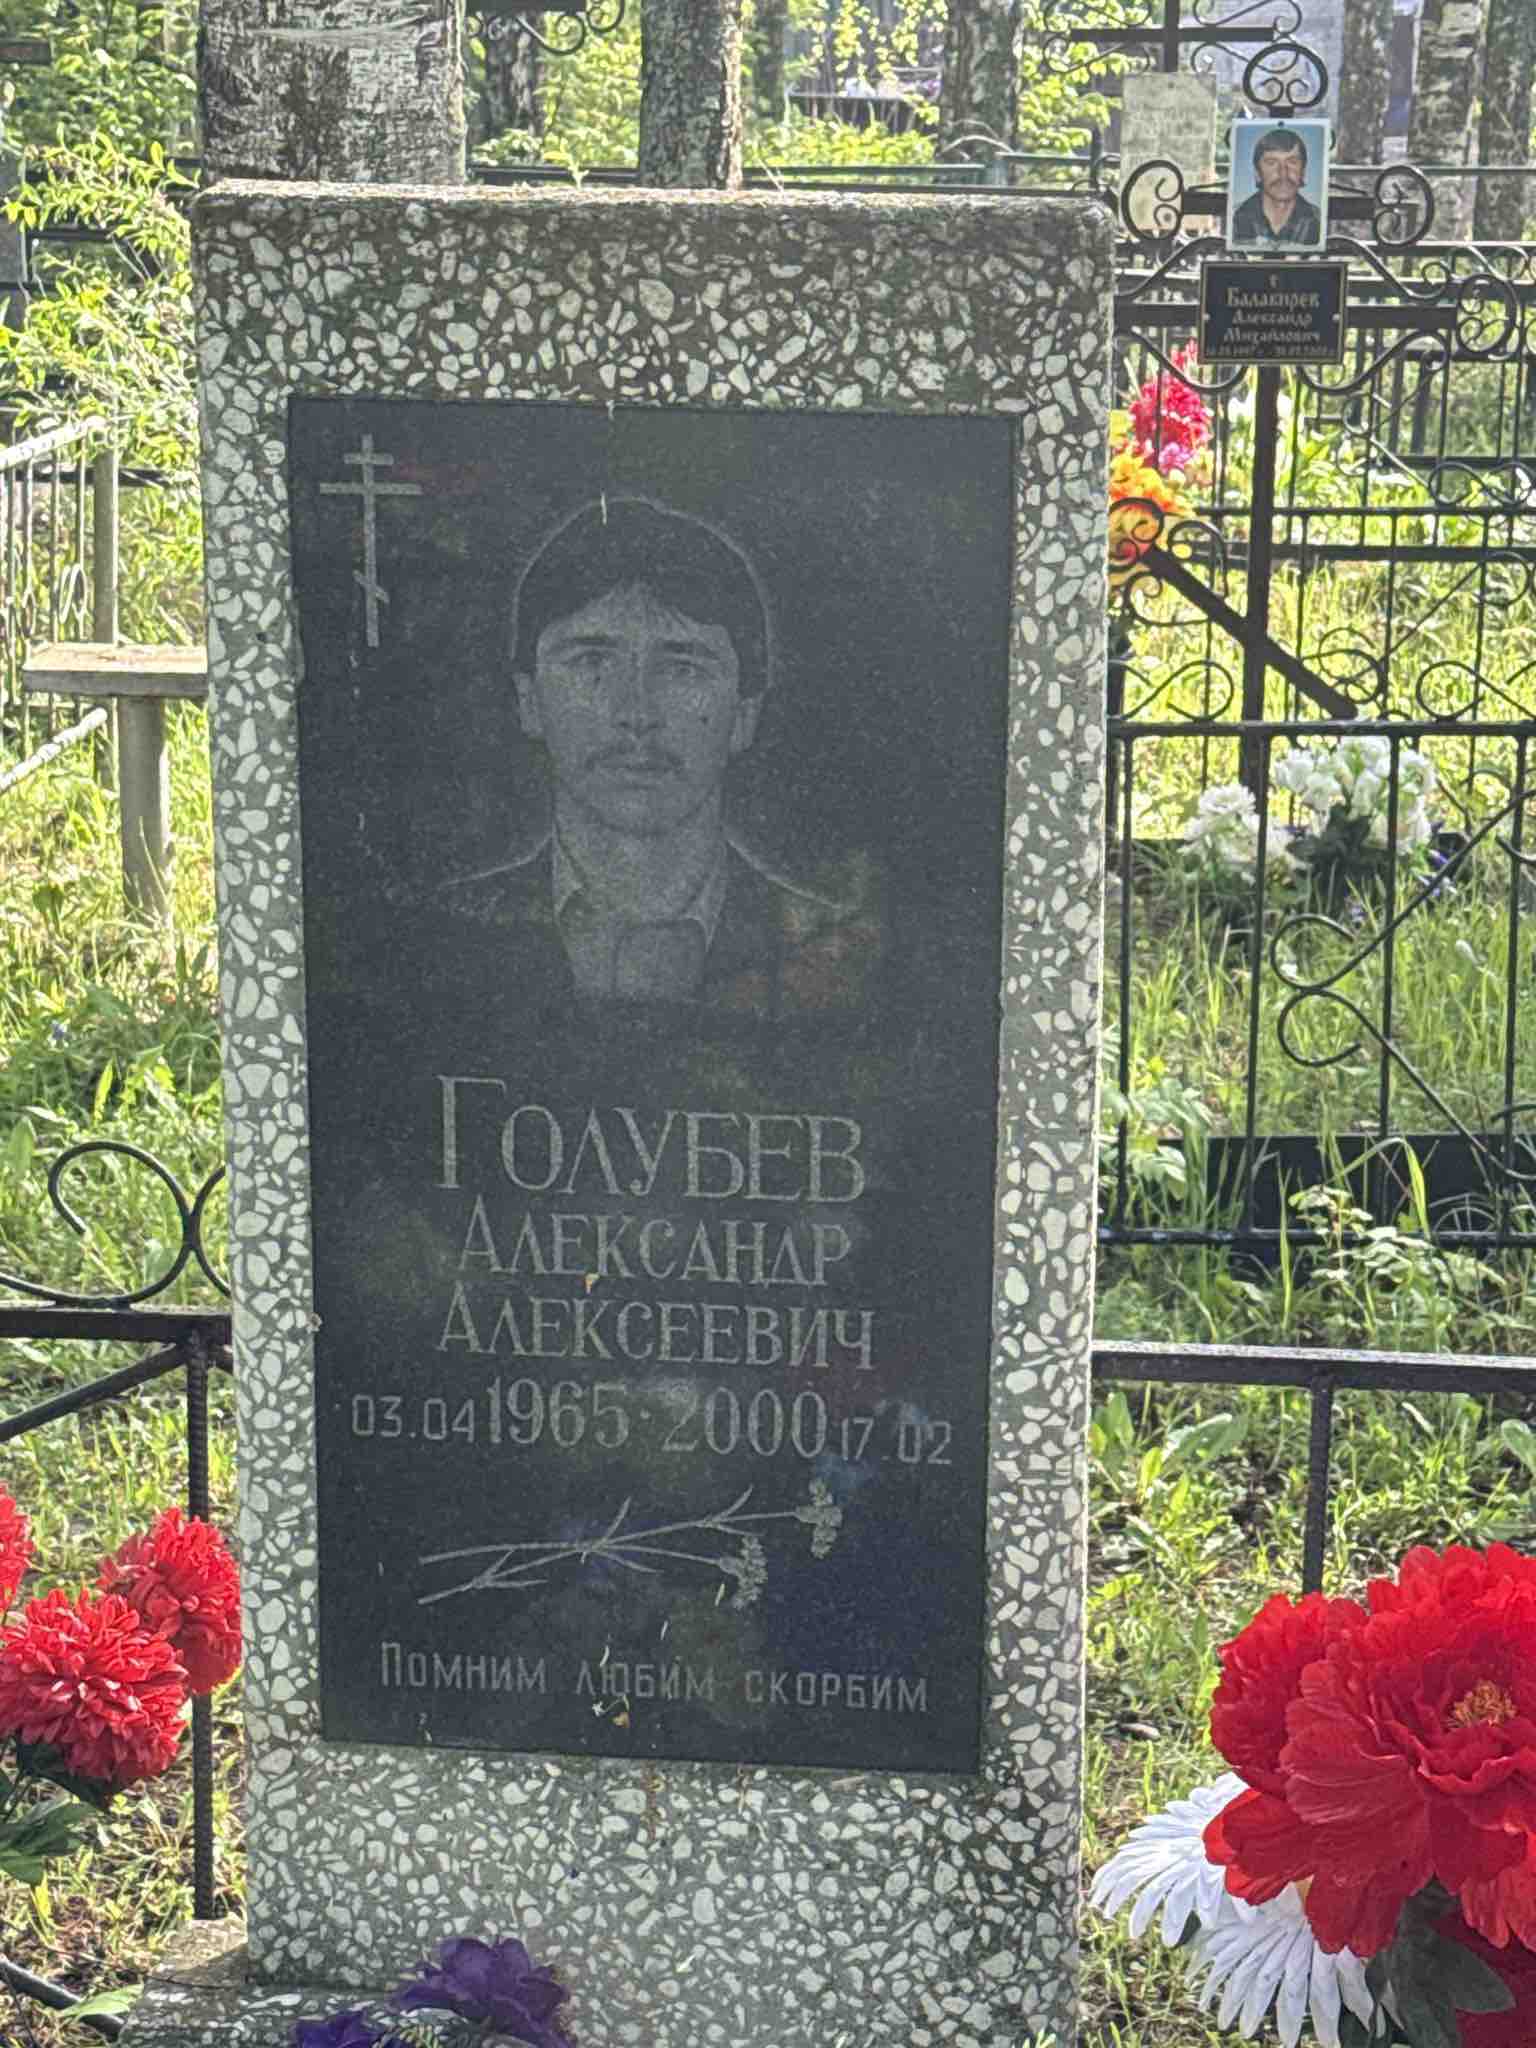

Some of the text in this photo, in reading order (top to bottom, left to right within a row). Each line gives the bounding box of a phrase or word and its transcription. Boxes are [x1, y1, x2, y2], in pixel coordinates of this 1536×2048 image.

[434, 1074, 867, 1202] ГОЛУБЕВ
[456, 1196, 853, 1288] АЛЕКСАНДР
[434, 1279, 877, 1370] АЛЕКСЕЕВИЧ
[351, 1393, 476, 1443] 03.04
[840, 1416, 953, 1465] 17.02
[379, 1640, 930, 1714] ПОМНИМ ЛЮБИМ СКОРБИМ
